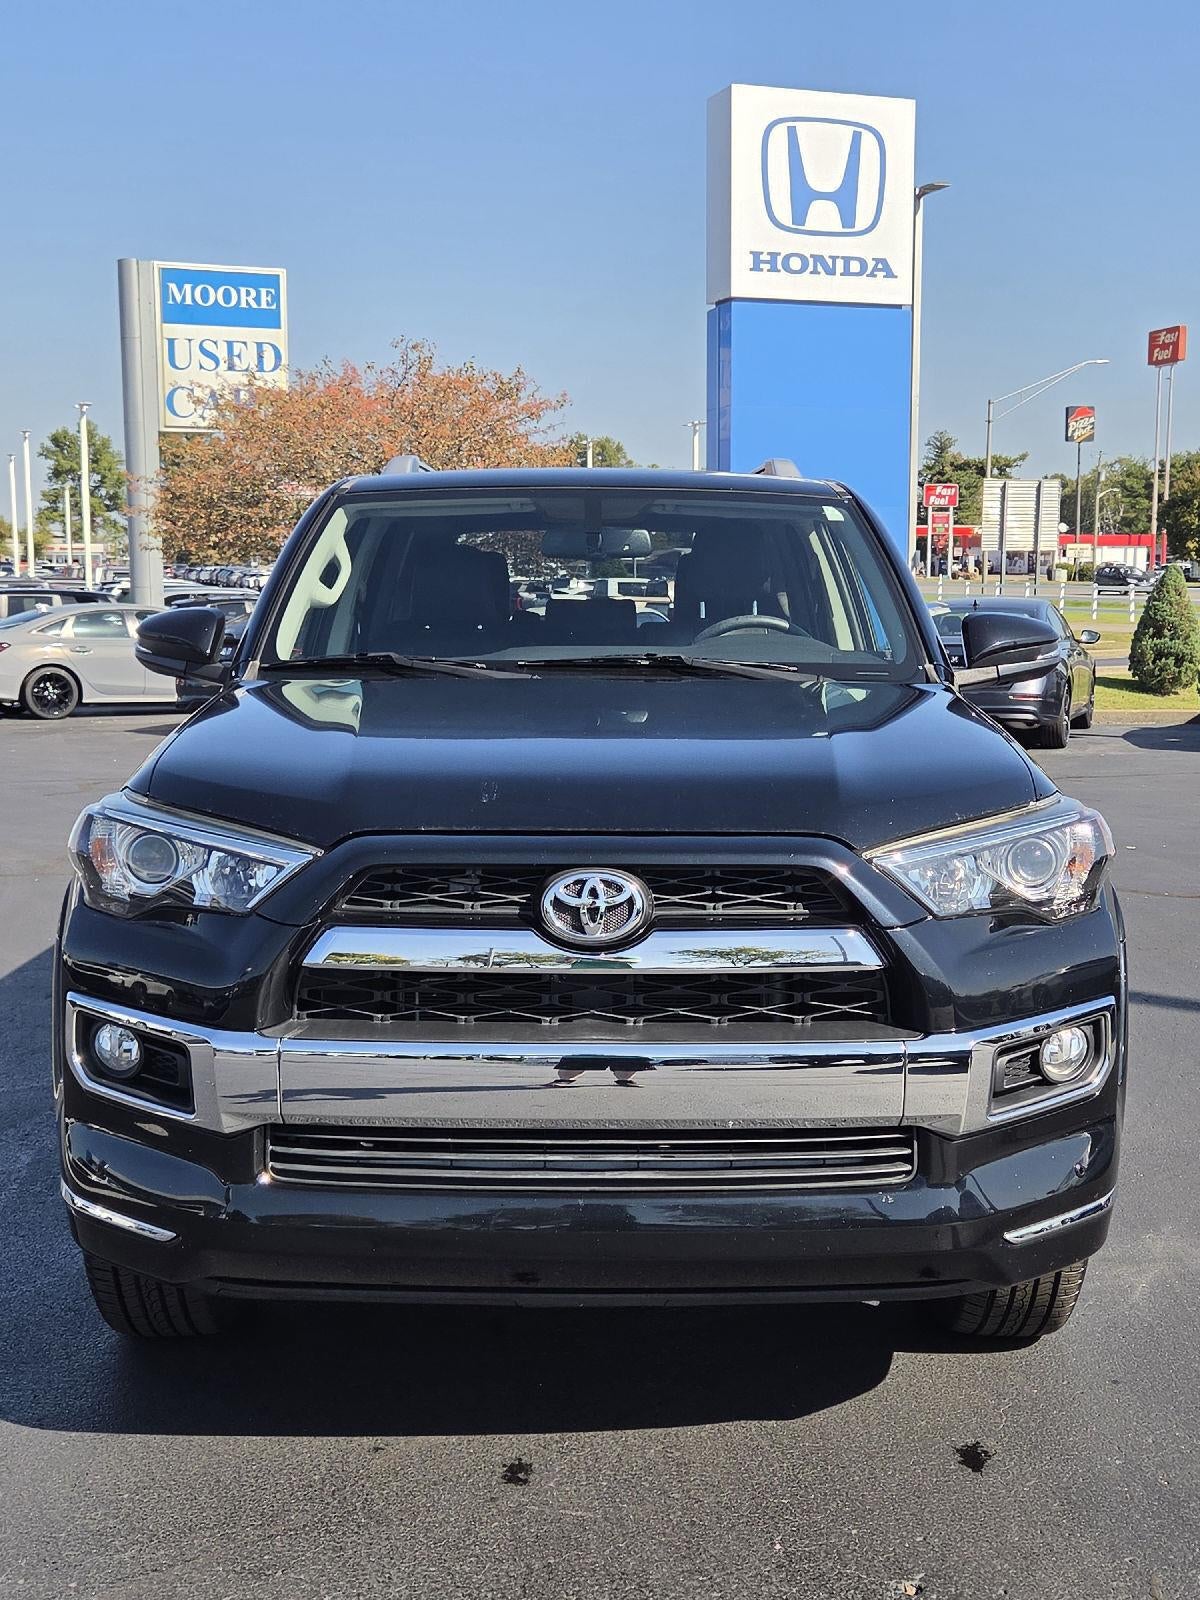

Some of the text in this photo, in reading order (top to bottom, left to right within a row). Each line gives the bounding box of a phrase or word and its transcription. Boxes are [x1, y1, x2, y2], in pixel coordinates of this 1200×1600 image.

[749, 250, 898, 279] HONDA
[166, 282, 277, 310] MOORE
[1158, 330, 1179, 345] Fast
[165, 337, 283, 374] USED
[1152, 345, 1173, 362] Fuel
[935, 485, 956, 496] Fast
[929, 495, 950, 505] Fuel
